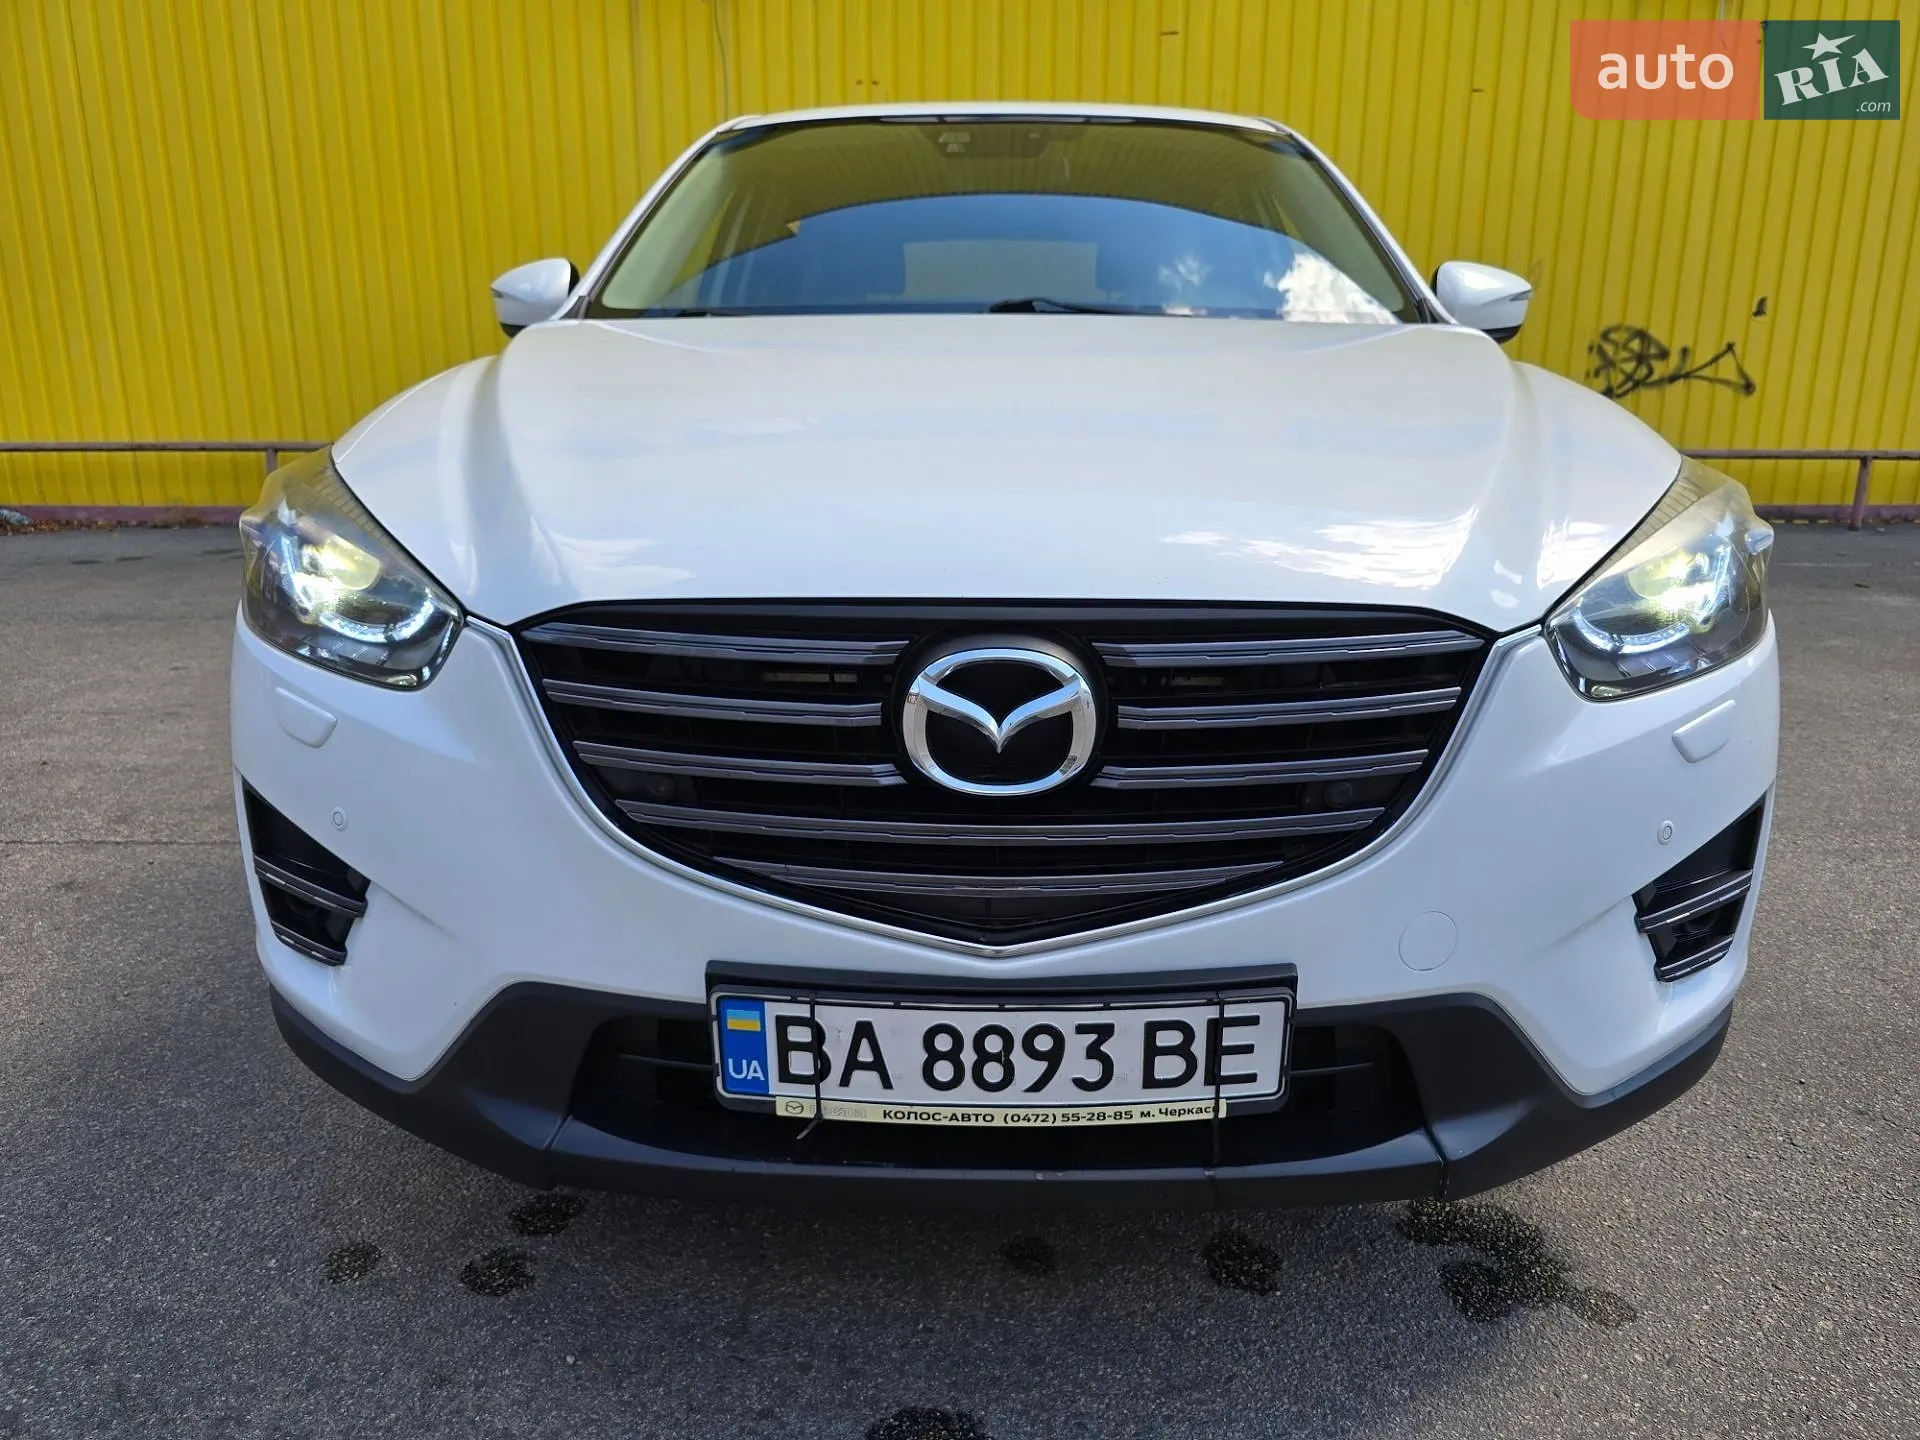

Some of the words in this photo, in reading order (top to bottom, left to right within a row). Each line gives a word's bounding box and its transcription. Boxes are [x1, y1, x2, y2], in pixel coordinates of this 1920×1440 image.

[775, 1014, 894, 1090] BA
[922, 1022, 1116, 1093] 8893
[1142, 1014, 1260, 1089] BE
[728, 1058, 766, 1081] UA
[882, 1110, 995, 1123] КОЛОС-АВТО
[1003, 1111, 1057, 1124] (0472)
[1061, 1110, 1134, 1122] 55-28-85
[1140, 1110, 1155, 1118] м.
